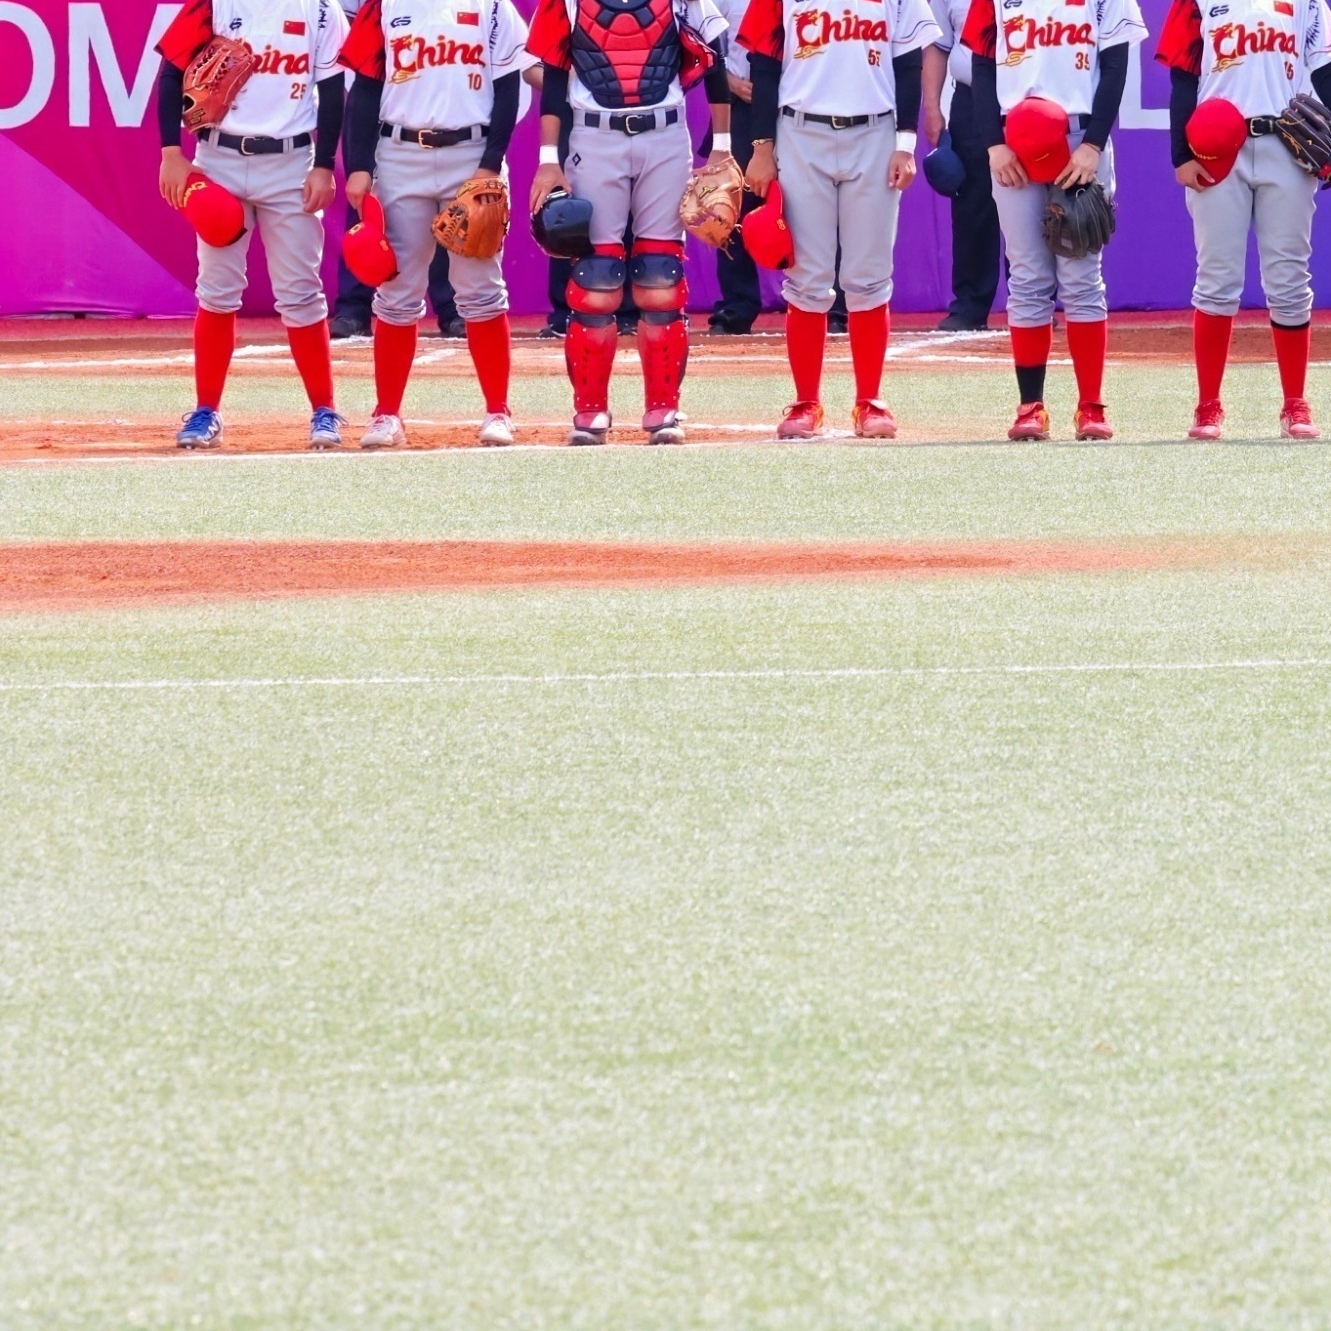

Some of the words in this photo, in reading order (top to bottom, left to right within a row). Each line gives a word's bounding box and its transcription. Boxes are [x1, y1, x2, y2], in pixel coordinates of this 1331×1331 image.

[793, 9, 888, 47] China
[1003, 14, 1096, 53] China
[1208, 21, 1299, 61] China
[390, 34, 486, 72] China
[468, 73, 483, 91] 10
